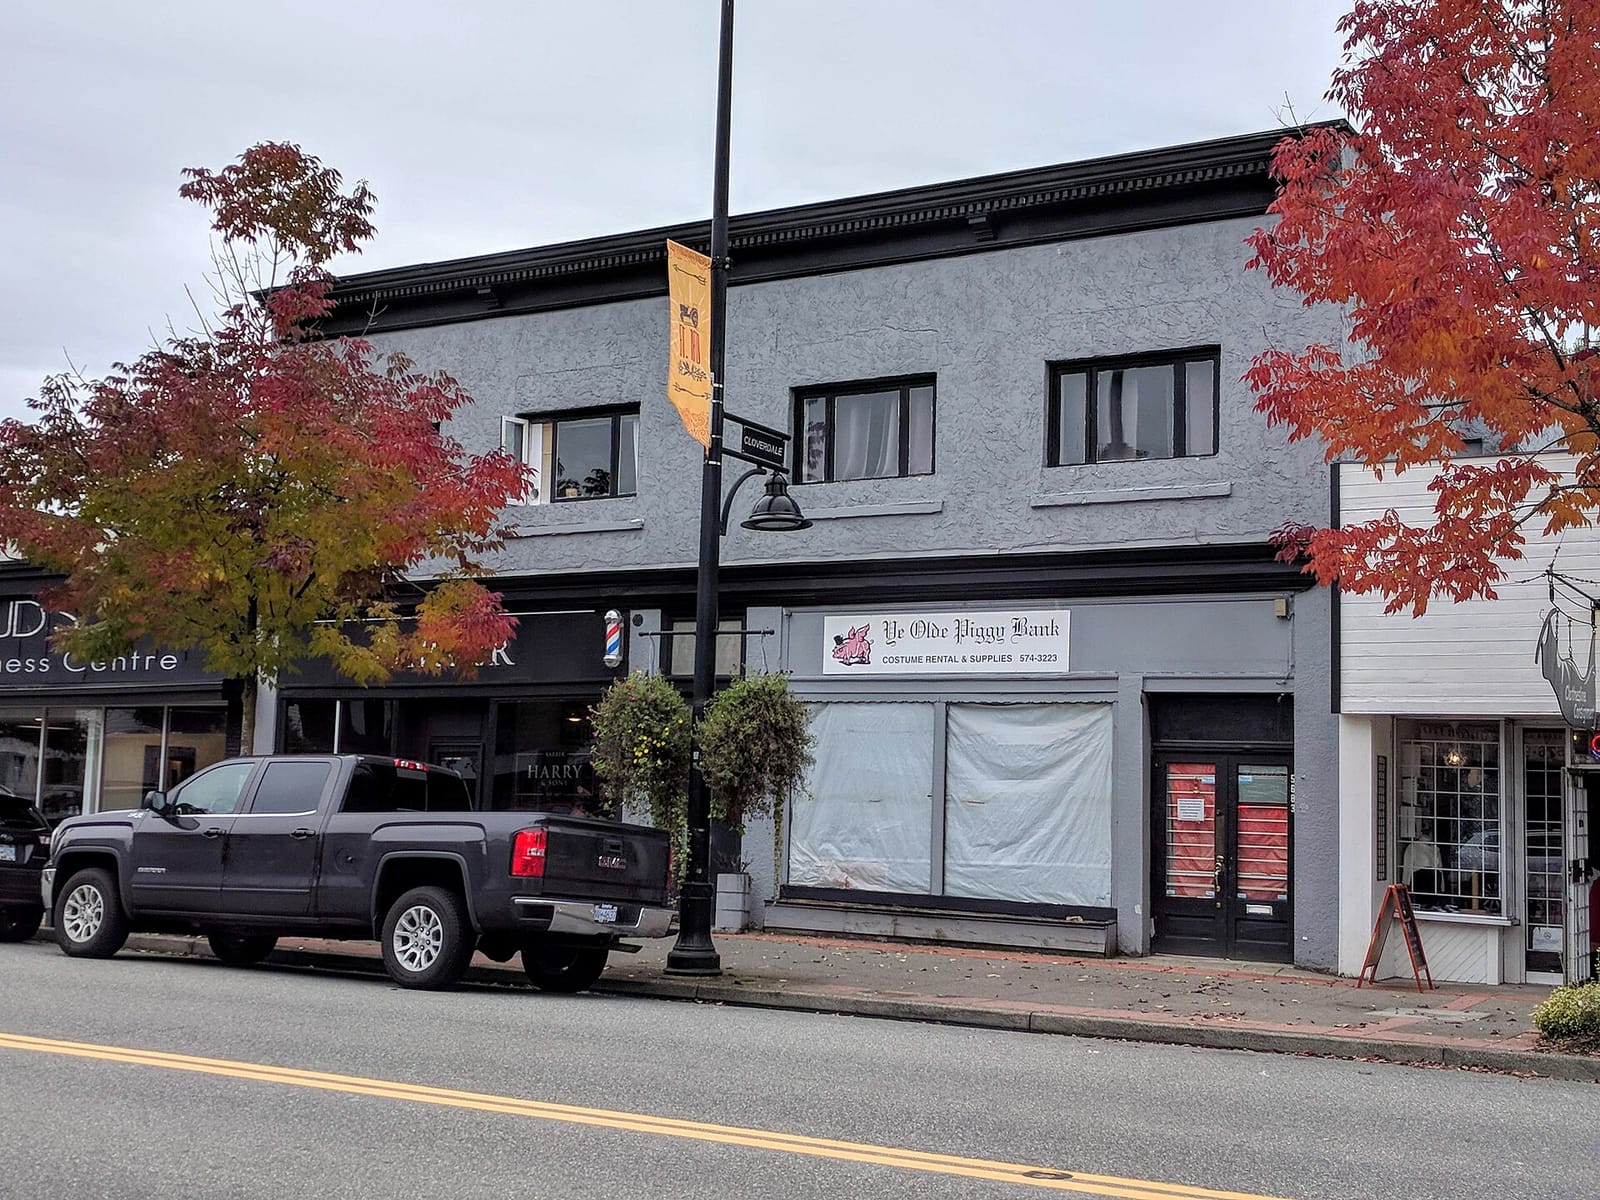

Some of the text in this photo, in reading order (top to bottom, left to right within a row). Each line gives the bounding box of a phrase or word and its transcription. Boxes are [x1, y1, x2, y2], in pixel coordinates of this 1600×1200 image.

[743, 435, 783, 457] CLOVERDALE
[882, 616, 1060, 647] Ye Olde Piggy Bank
[0, 655, 50, 673] ess
[882, 653, 1058, 664] COSTUME RENTAL & SUPPLIES 574-3223
[527, 764, 583, 779] HARRY
